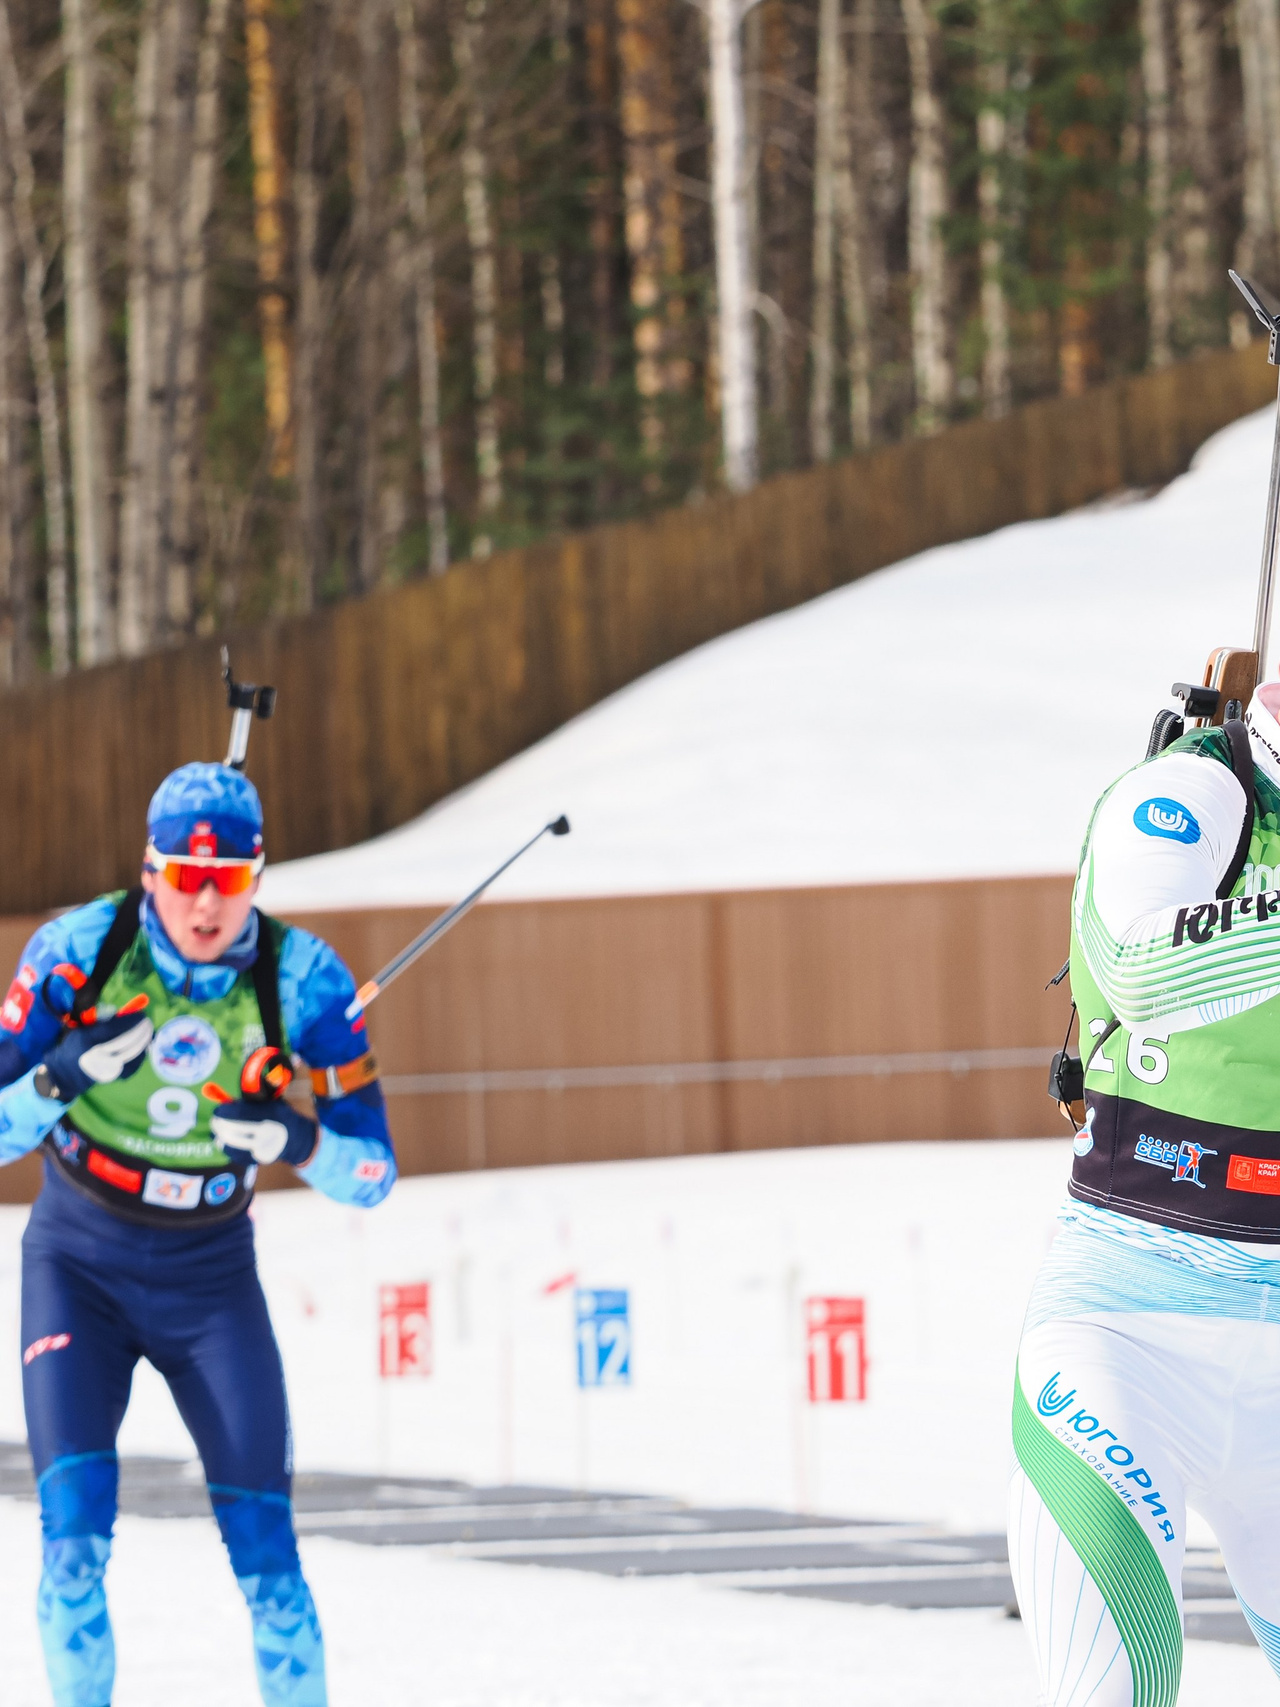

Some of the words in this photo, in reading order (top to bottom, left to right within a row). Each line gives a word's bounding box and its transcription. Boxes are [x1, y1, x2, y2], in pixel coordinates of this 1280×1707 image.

[147, 1086, 198, 1138] 9
[1135, 1142, 1177, 1163] СБР
[1258, 1169, 1278, 1177] КРАЙ
[381, 1313, 432, 1376] 13
[580, 1321, 629, 1386] 12
[810, 1331, 858, 1400] 11
[1055, 1427, 1138, 1507] СТРАХОВАНИЕ
[1067, 1409, 1175, 1542] ЮГОРИЯ
